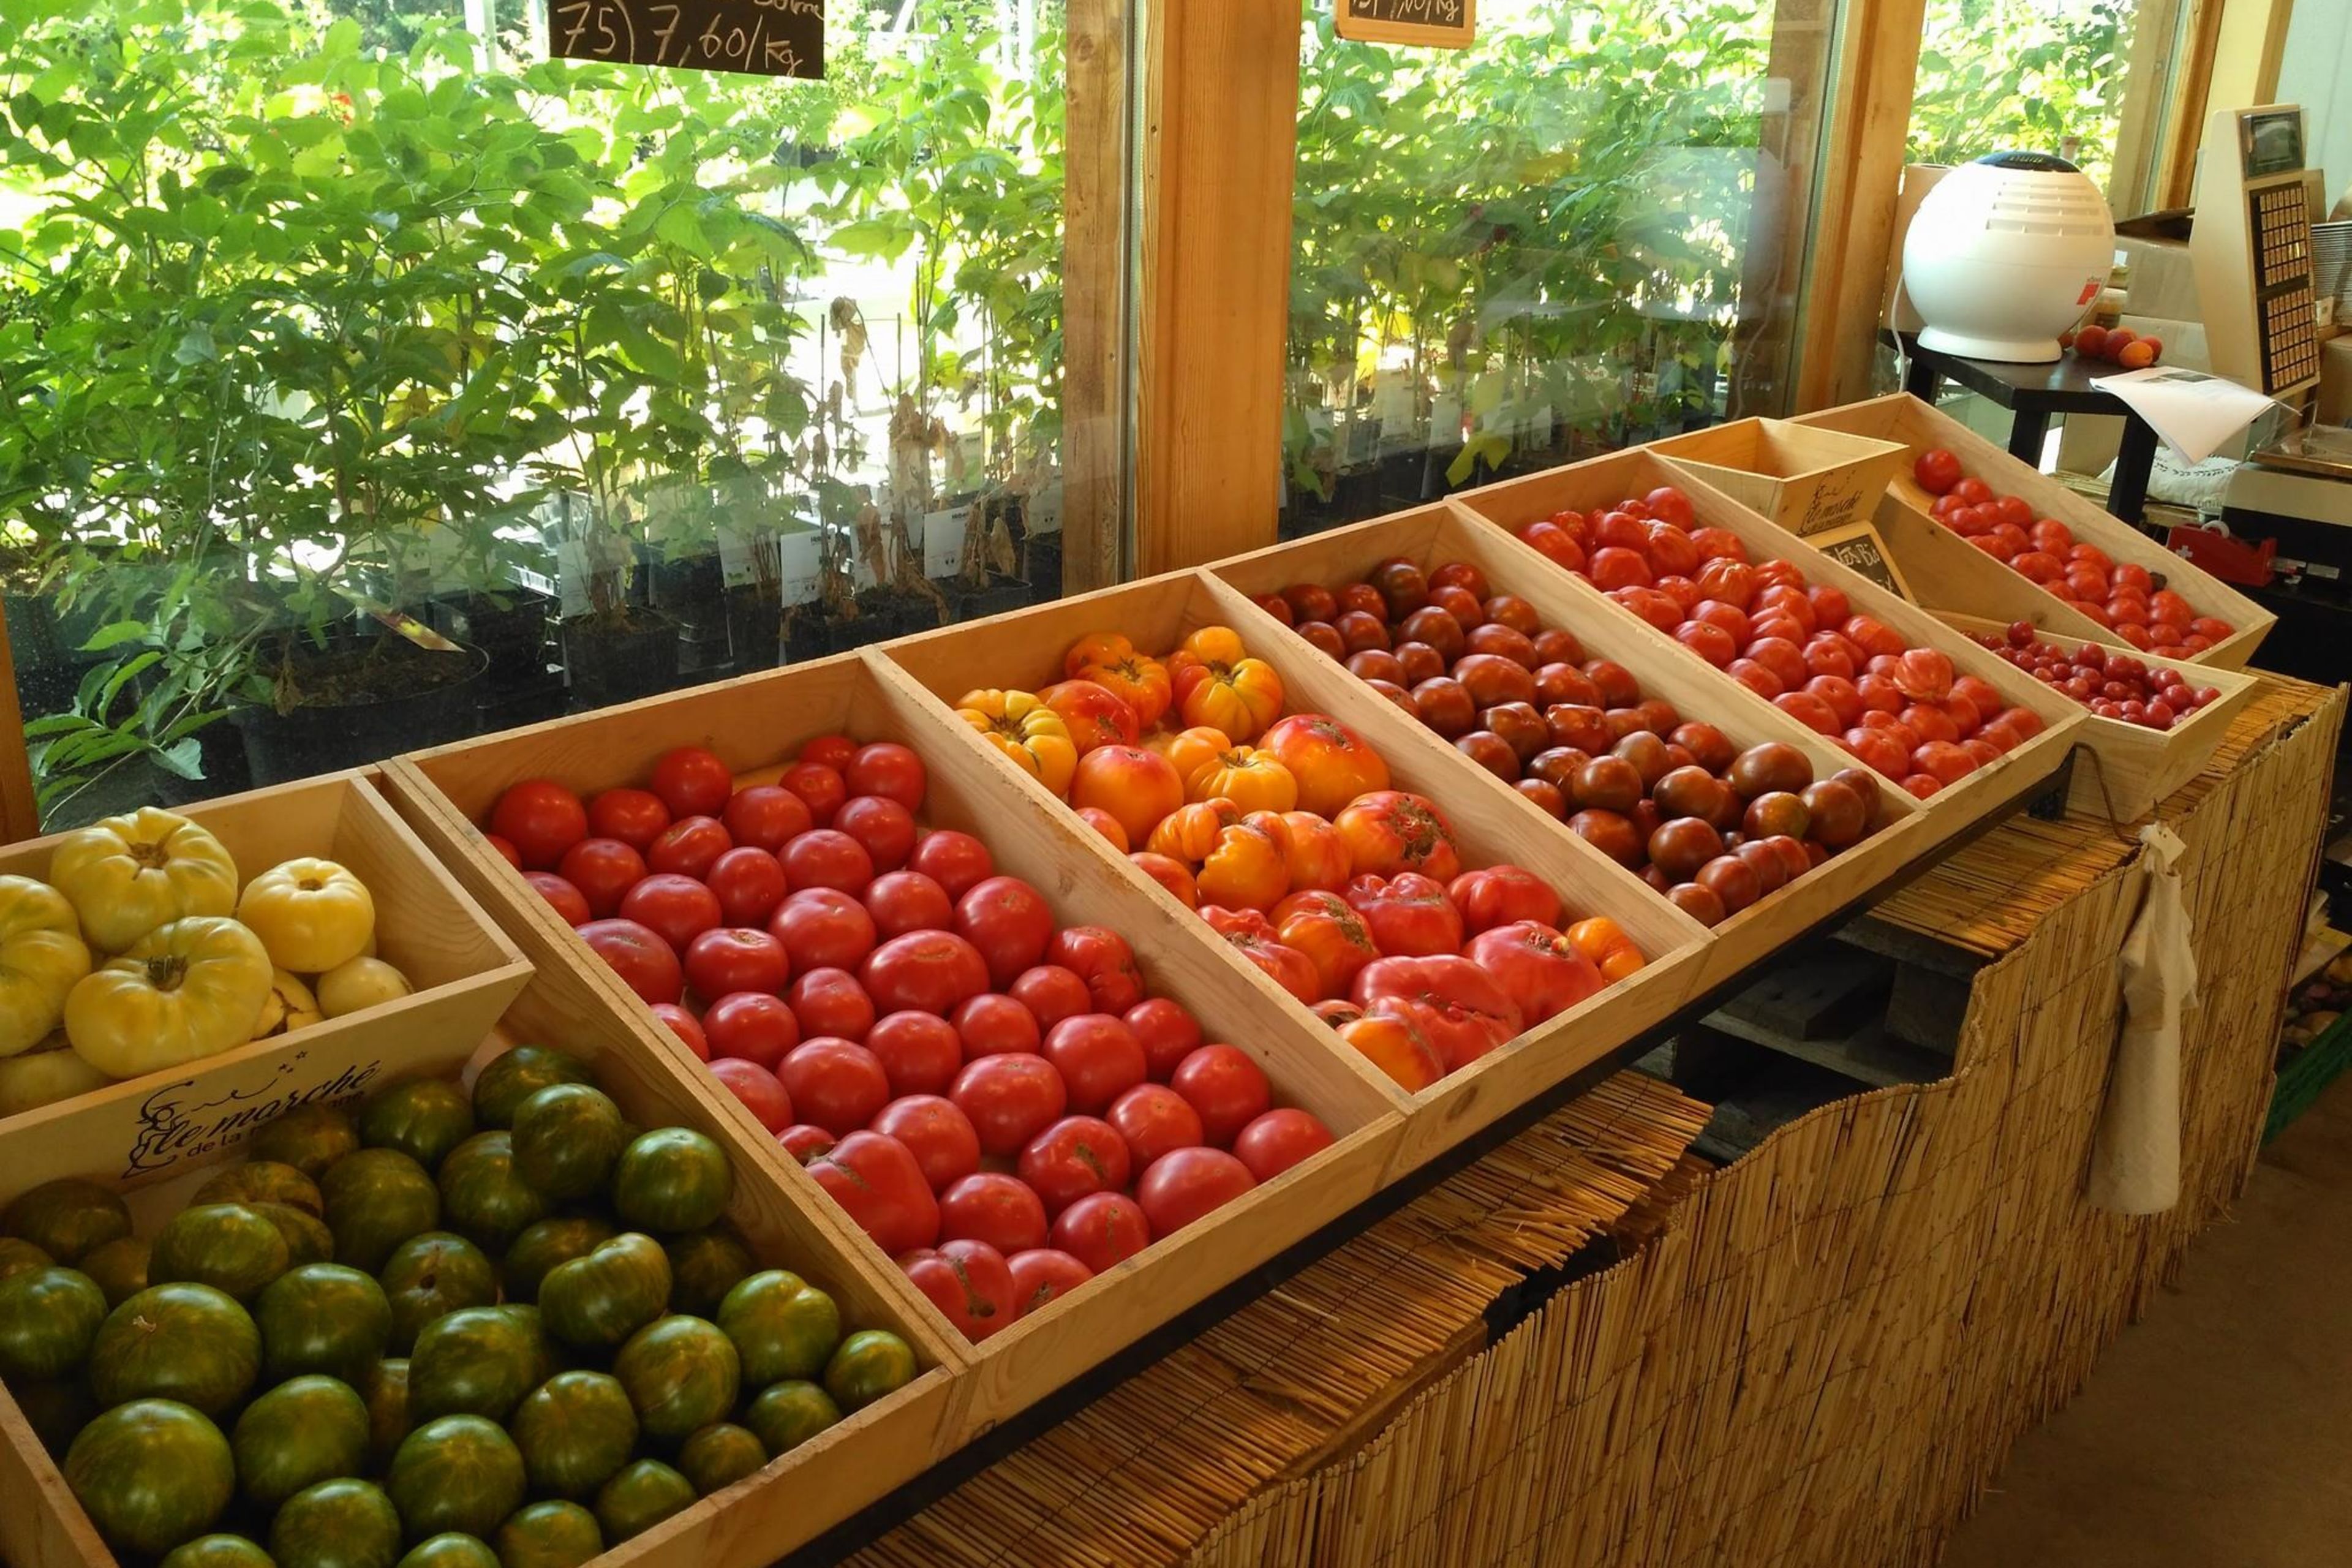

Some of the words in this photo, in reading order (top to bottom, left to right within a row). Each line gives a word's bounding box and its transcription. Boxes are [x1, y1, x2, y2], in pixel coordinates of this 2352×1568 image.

[207, 1060, 381, 1138] marché
[186, 1140, 216, 1158] de
[221, 1133, 242, 1147] la
